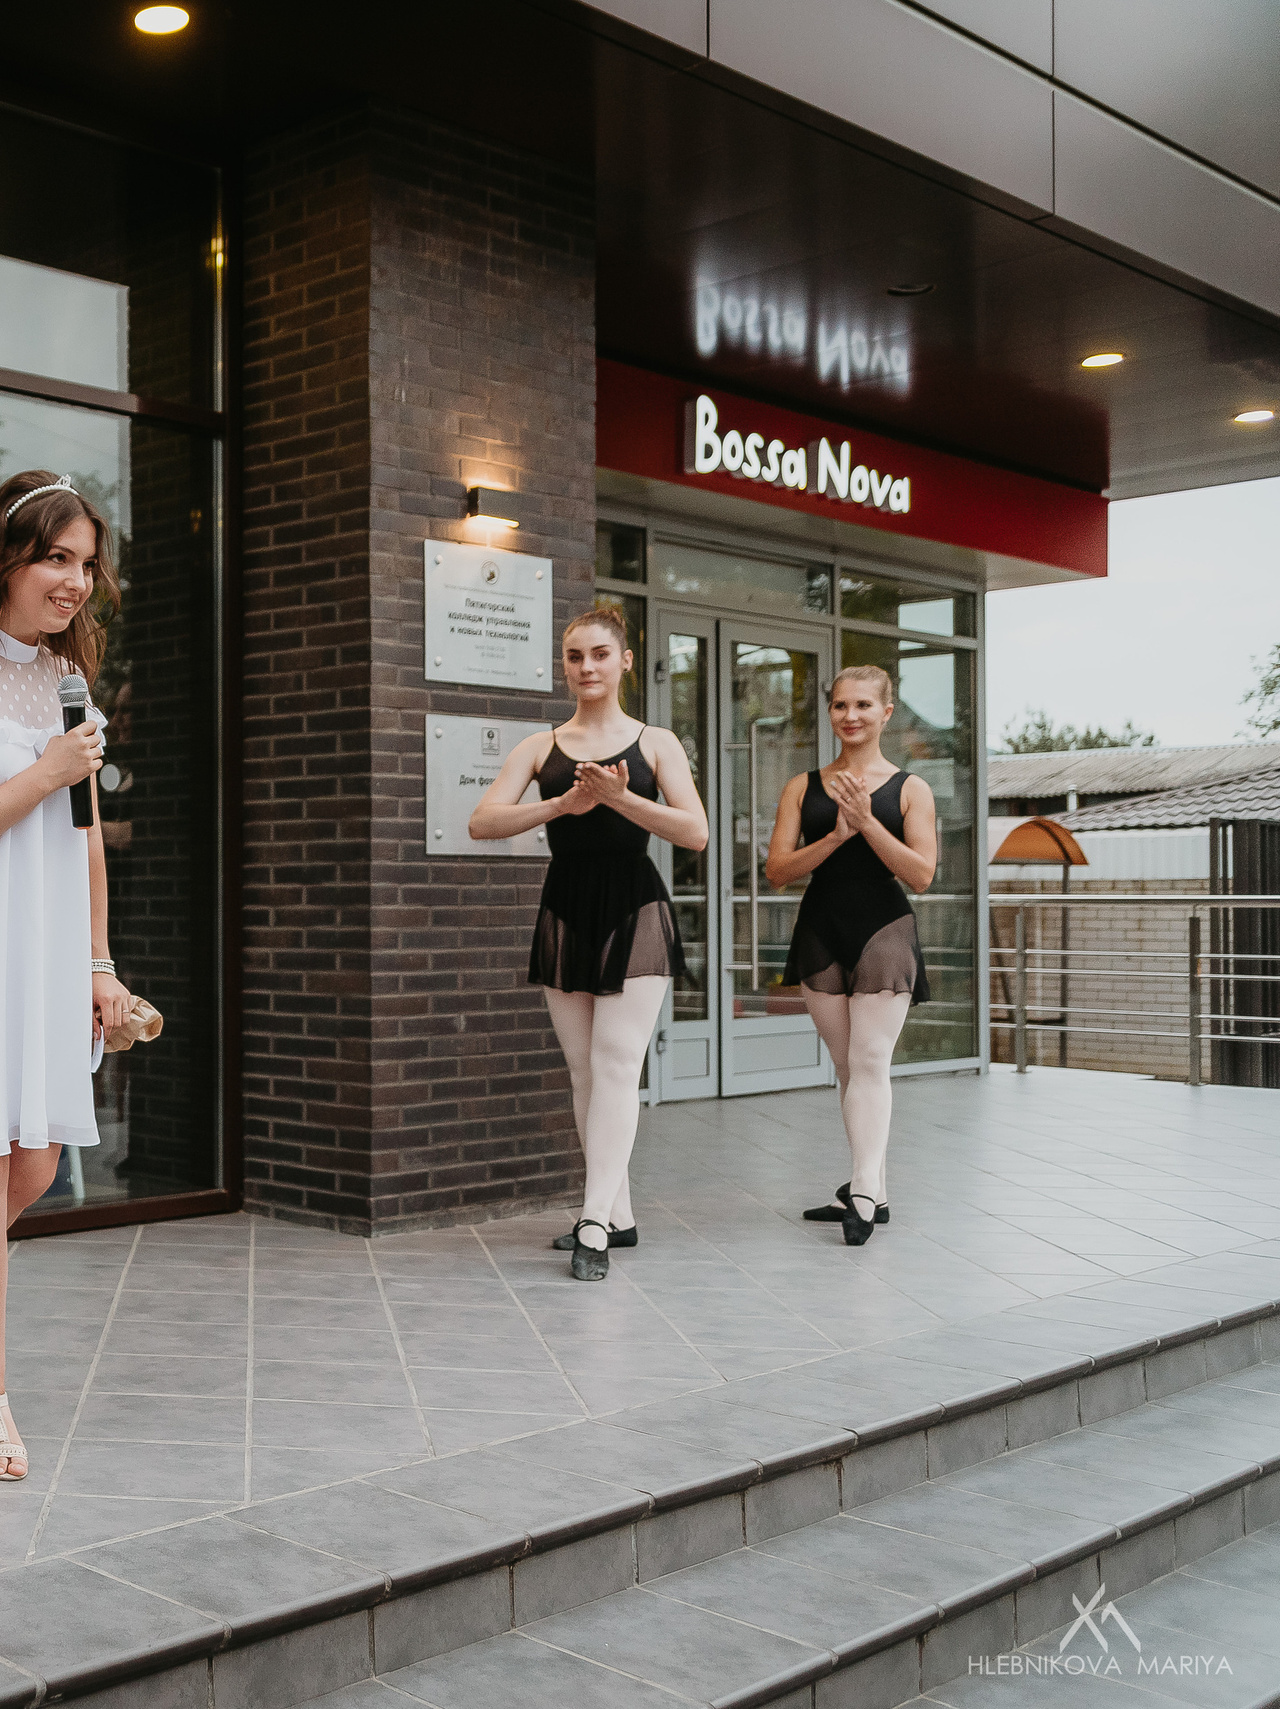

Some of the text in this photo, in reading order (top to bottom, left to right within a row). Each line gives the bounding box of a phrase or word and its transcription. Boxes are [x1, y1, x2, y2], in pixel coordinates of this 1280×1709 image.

[695, 394, 911, 513] Bossa Nova
[465, 598, 515, 613] Пятигорский
[448, 611, 531, 629] колледж управления
[457, 627, 482, 636] новых
[485, 630, 529, 642] технологий
